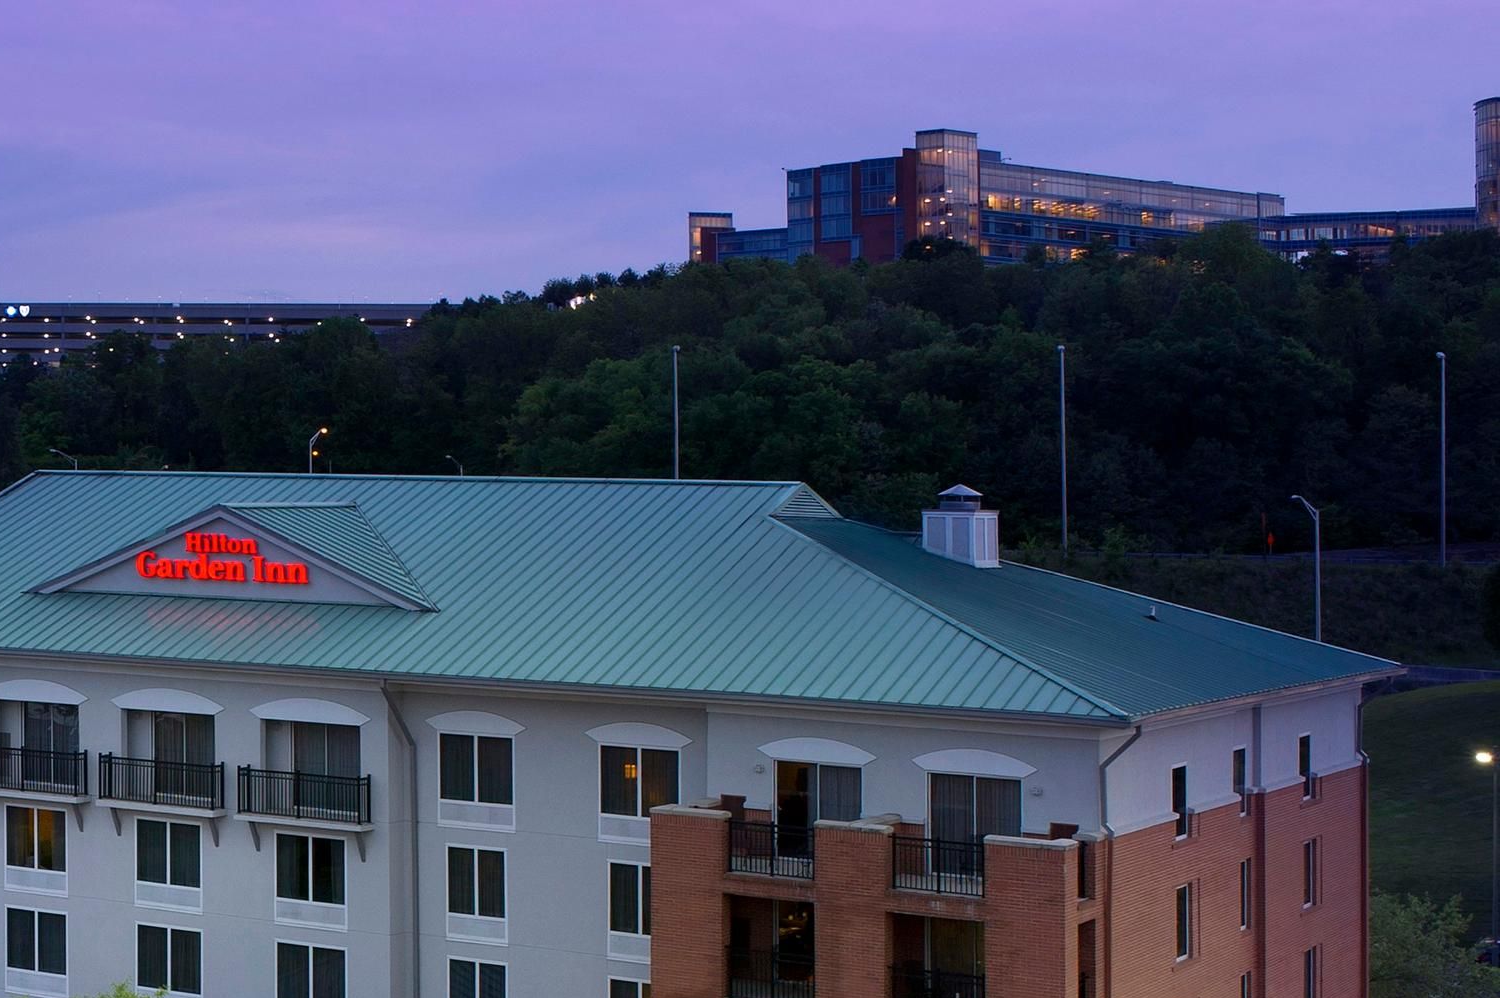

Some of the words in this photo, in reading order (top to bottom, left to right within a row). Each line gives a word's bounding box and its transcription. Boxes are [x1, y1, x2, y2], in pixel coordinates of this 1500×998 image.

[185, 532, 257, 554] Hilton
[136, 551, 246, 582] Garden
[252, 555, 309, 584] Inn
